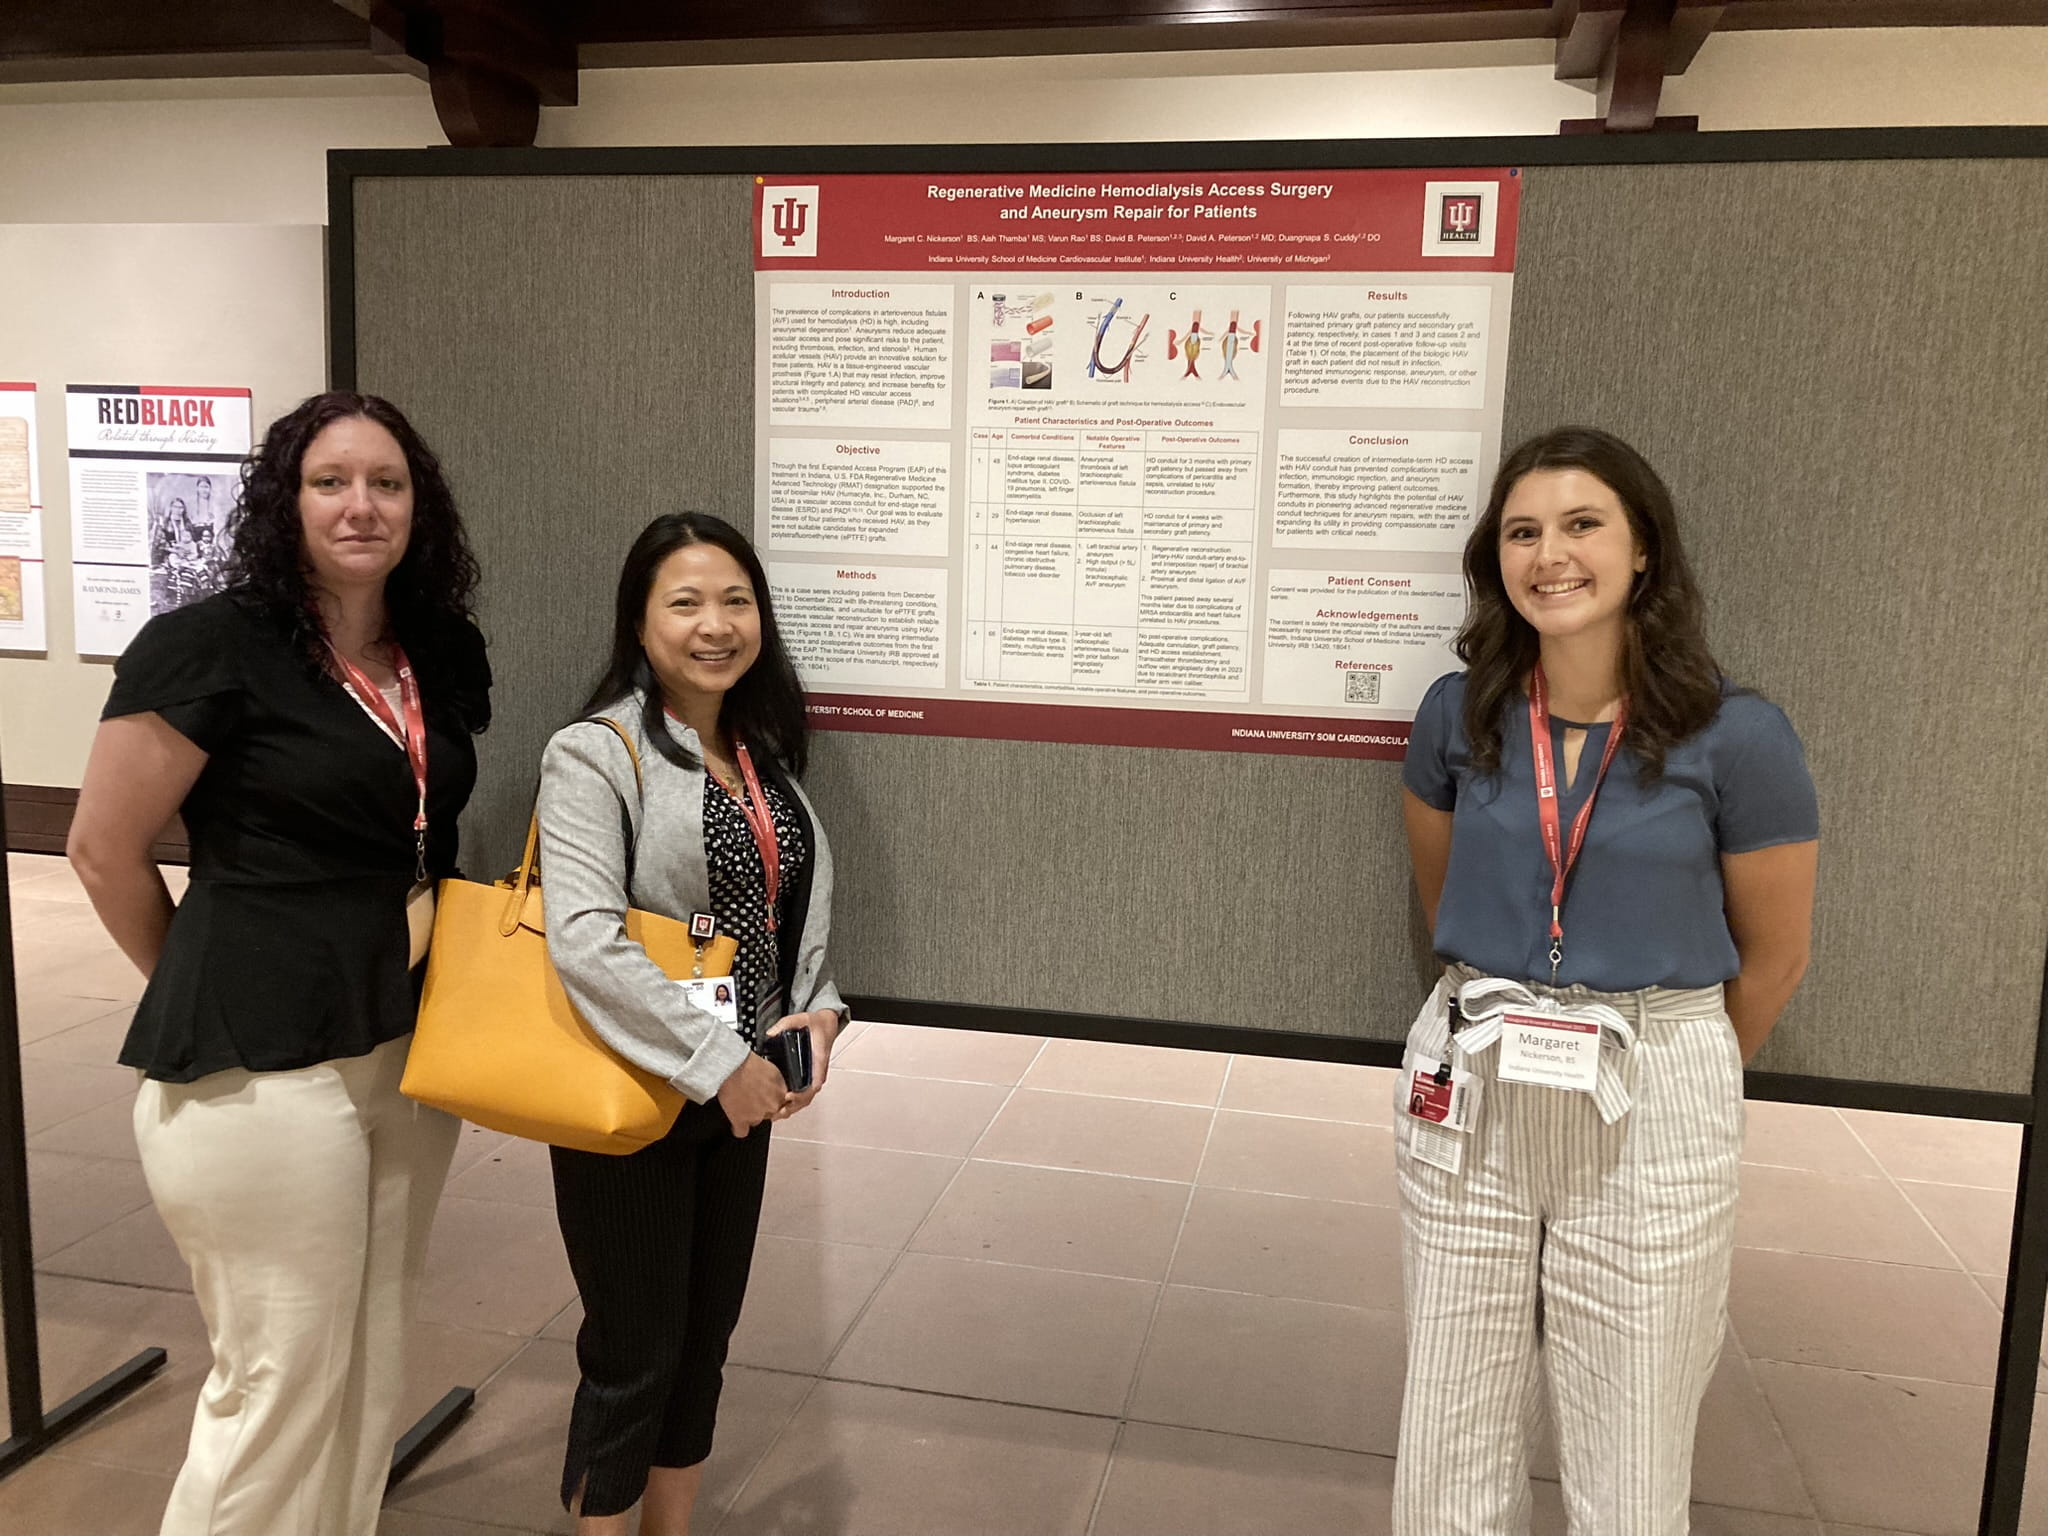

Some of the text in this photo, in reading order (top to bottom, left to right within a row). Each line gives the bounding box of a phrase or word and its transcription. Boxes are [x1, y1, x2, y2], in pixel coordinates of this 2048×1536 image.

[927, 182, 1333, 201] Regenerative Medicine Hemodialysis Access Surgery
[1000, 205, 1257, 222] and Aneurysm Repair for Patients
[884, 235, 915, 244] Margaret
[1186, 234, 1206, 242] David
[1279, 234, 1321, 243] Duangnapa
[1368, 234, 1380, 242] DO
[956, 256, 988, 264] University
[1018, 255, 1024, 263] of
[1150, 255, 1175, 263] Indiana
[1178, 255, 1213, 265] University
[1247, 255, 1282, 265] University
[1285, 254, 1293, 263] of
[832, 289, 890, 298] Introduction
[1076, 292, 1082, 300] B
[1170, 292, 1176, 300] C
[1368, 291, 1408, 300] Results
[829, 309, 871, 317] complications
[1288, 312, 1320, 320] Following
[1378, 312, 1404, 320] patients
[1408, 312, 1450, 320] successfully
[1374, 322, 1401, 330] patency
[1419, 322, 1455, 330] secondary
[1457, 322, 1473, 330] graft
[1116, 418, 1172, 426] Post-Operative
[139, 429, 176, 450] through
[178, 430, 216, 451] History
[1349, 435, 1409, 445] Conclusion
[836, 445, 880, 455] Objective
[1296, 455, 1331, 463] successful
[1372, 456, 1433, 464] intermediate-term
[772, 462, 796, 471] Through
[822, 464, 852, 472] Expanded
[879, 466, 905, 474] Program
[908, 466, 926, 474] (EAP)
[837, 570, 877, 580] Methods
[1328, 576, 1411, 587] Patient Consent
[858, 598, 903, 607] life-threatening
[1316, 609, 1419, 621] Acknowledgements
[1335, 660, 1393, 671] References
[843, 707, 874, 716] SCHOOL
[876, 709, 886, 717] OF
[888, 710, 924, 719] MEDICINE
[1232, 729, 1409, 745] INDIANA UNIVERSITY SOM CARDIOVASCULA
[1519, 1033, 1580, 1051] Margaret
[1520, 1050, 1563, 1063] Nickerson,
